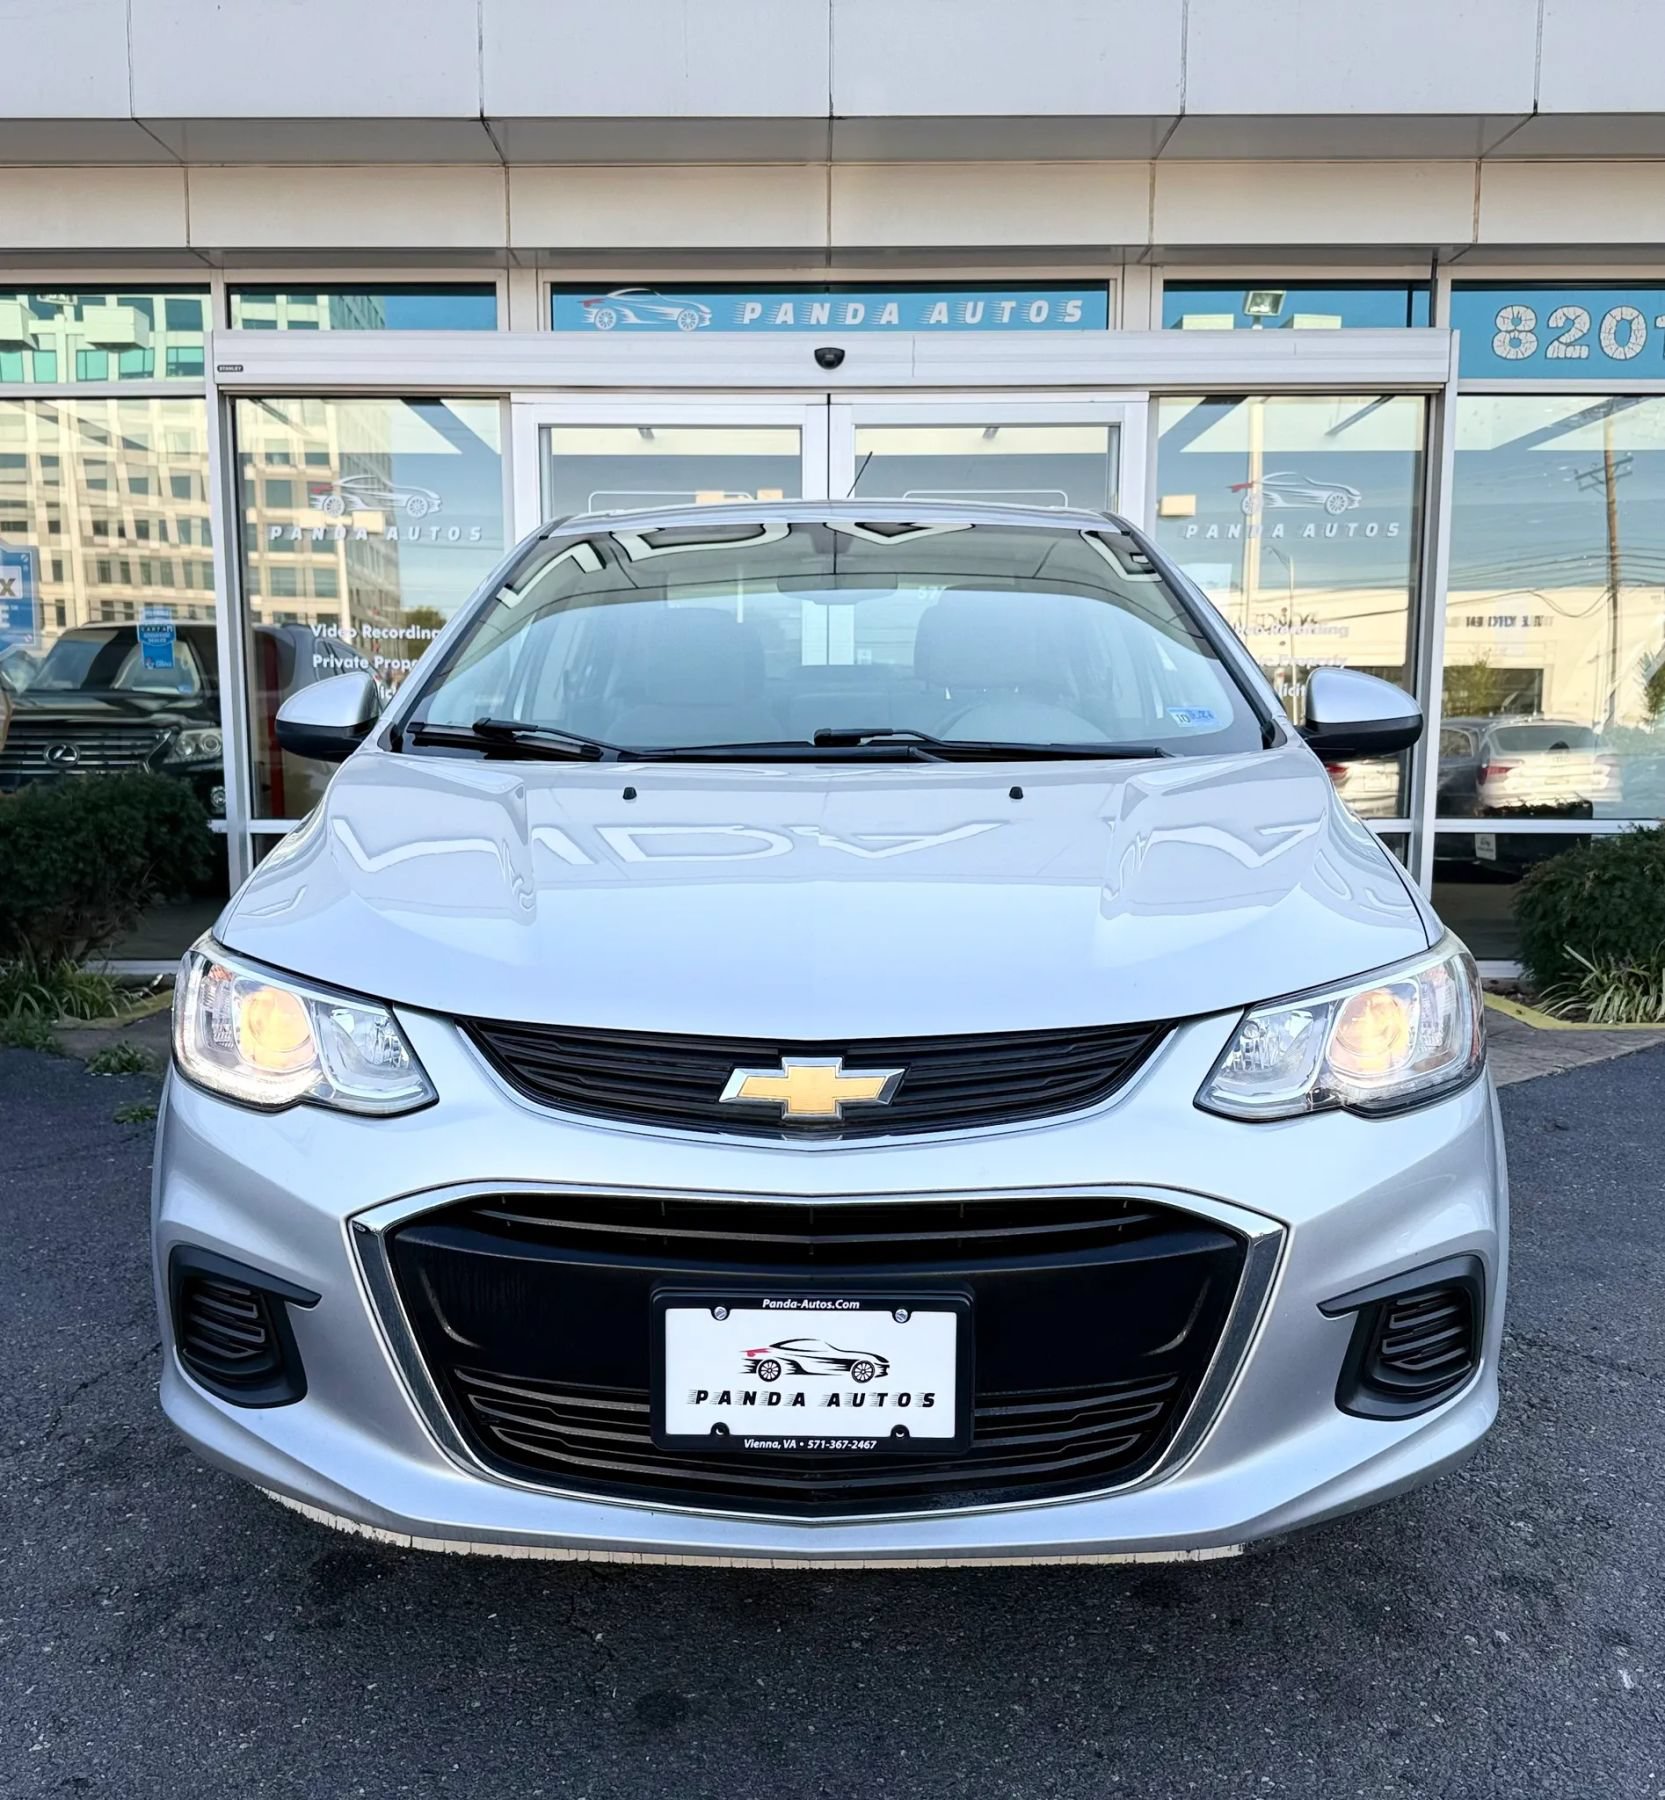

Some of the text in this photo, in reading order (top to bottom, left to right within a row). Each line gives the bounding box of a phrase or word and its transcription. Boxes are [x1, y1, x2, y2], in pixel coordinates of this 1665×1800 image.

[735, 300, 1083, 325] PANDA AUTOS
[269, 525, 483, 541] PANDA AUTOS
[1184, 521, 1400, 539] PANDA AUTOS
[311, 623, 357, 638] Video
[312, 654, 369, 669] Private
[762, 1298, 860, 1310] Panda-Autos.Com
[688, 1389, 935, 1408] PANDA AUTOS
[743, 1438, 877, 1450] Vienna, VA 571-367-2467
